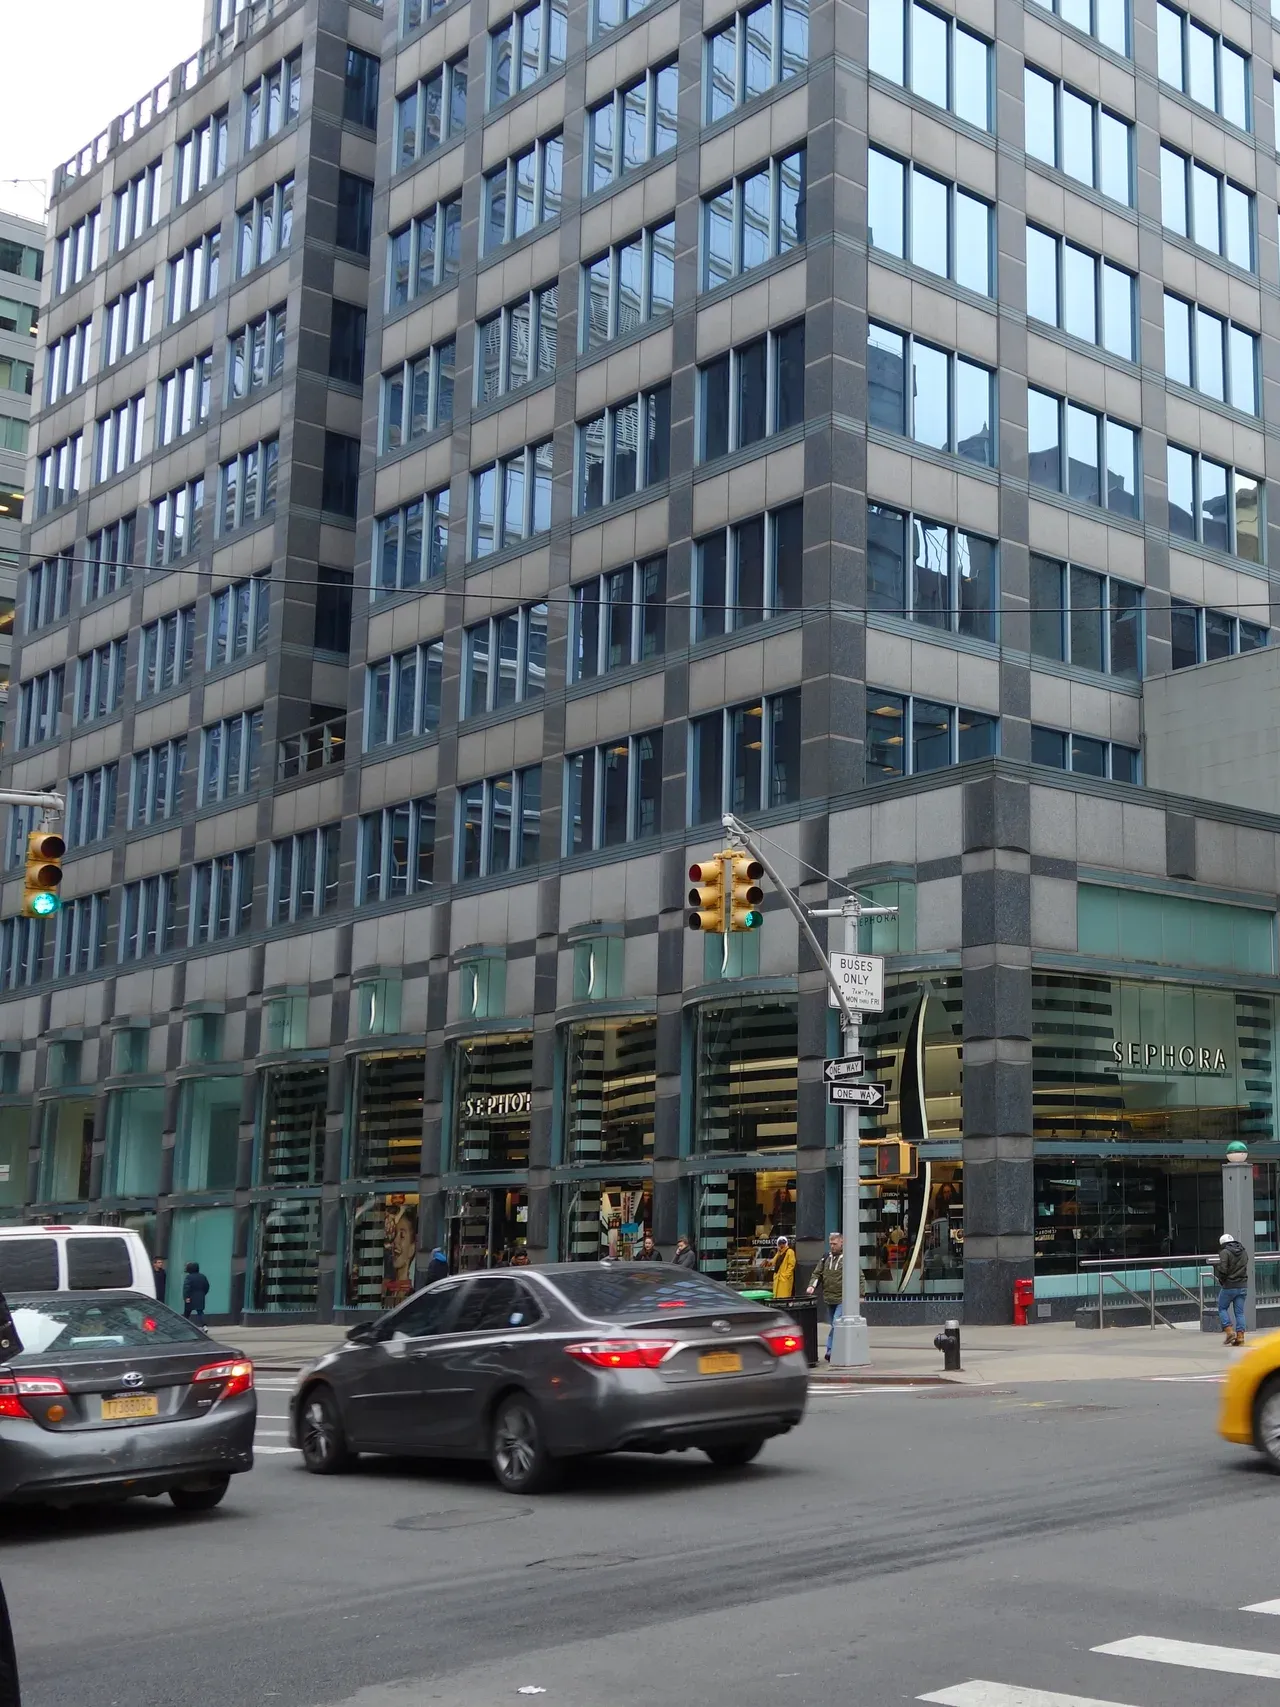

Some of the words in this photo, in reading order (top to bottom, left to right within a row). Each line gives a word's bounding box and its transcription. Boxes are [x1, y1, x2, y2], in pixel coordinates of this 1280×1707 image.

[860, 914, 897, 926] EPHORA
[840, 958, 873, 972] BUSES
[843, 973, 869, 985] ONLY
[846, 996, 858, 1004] MON
[871, 998, 880, 1006] FRI
[1112, 1041, 1228, 1070] SEPHORA
[830, 1065, 842, 1075] ONE
[846, 1062, 859, 1073] WAY
[837, 1089, 854, 1099] ONE
[860, 1090, 877, 1100] WAY
